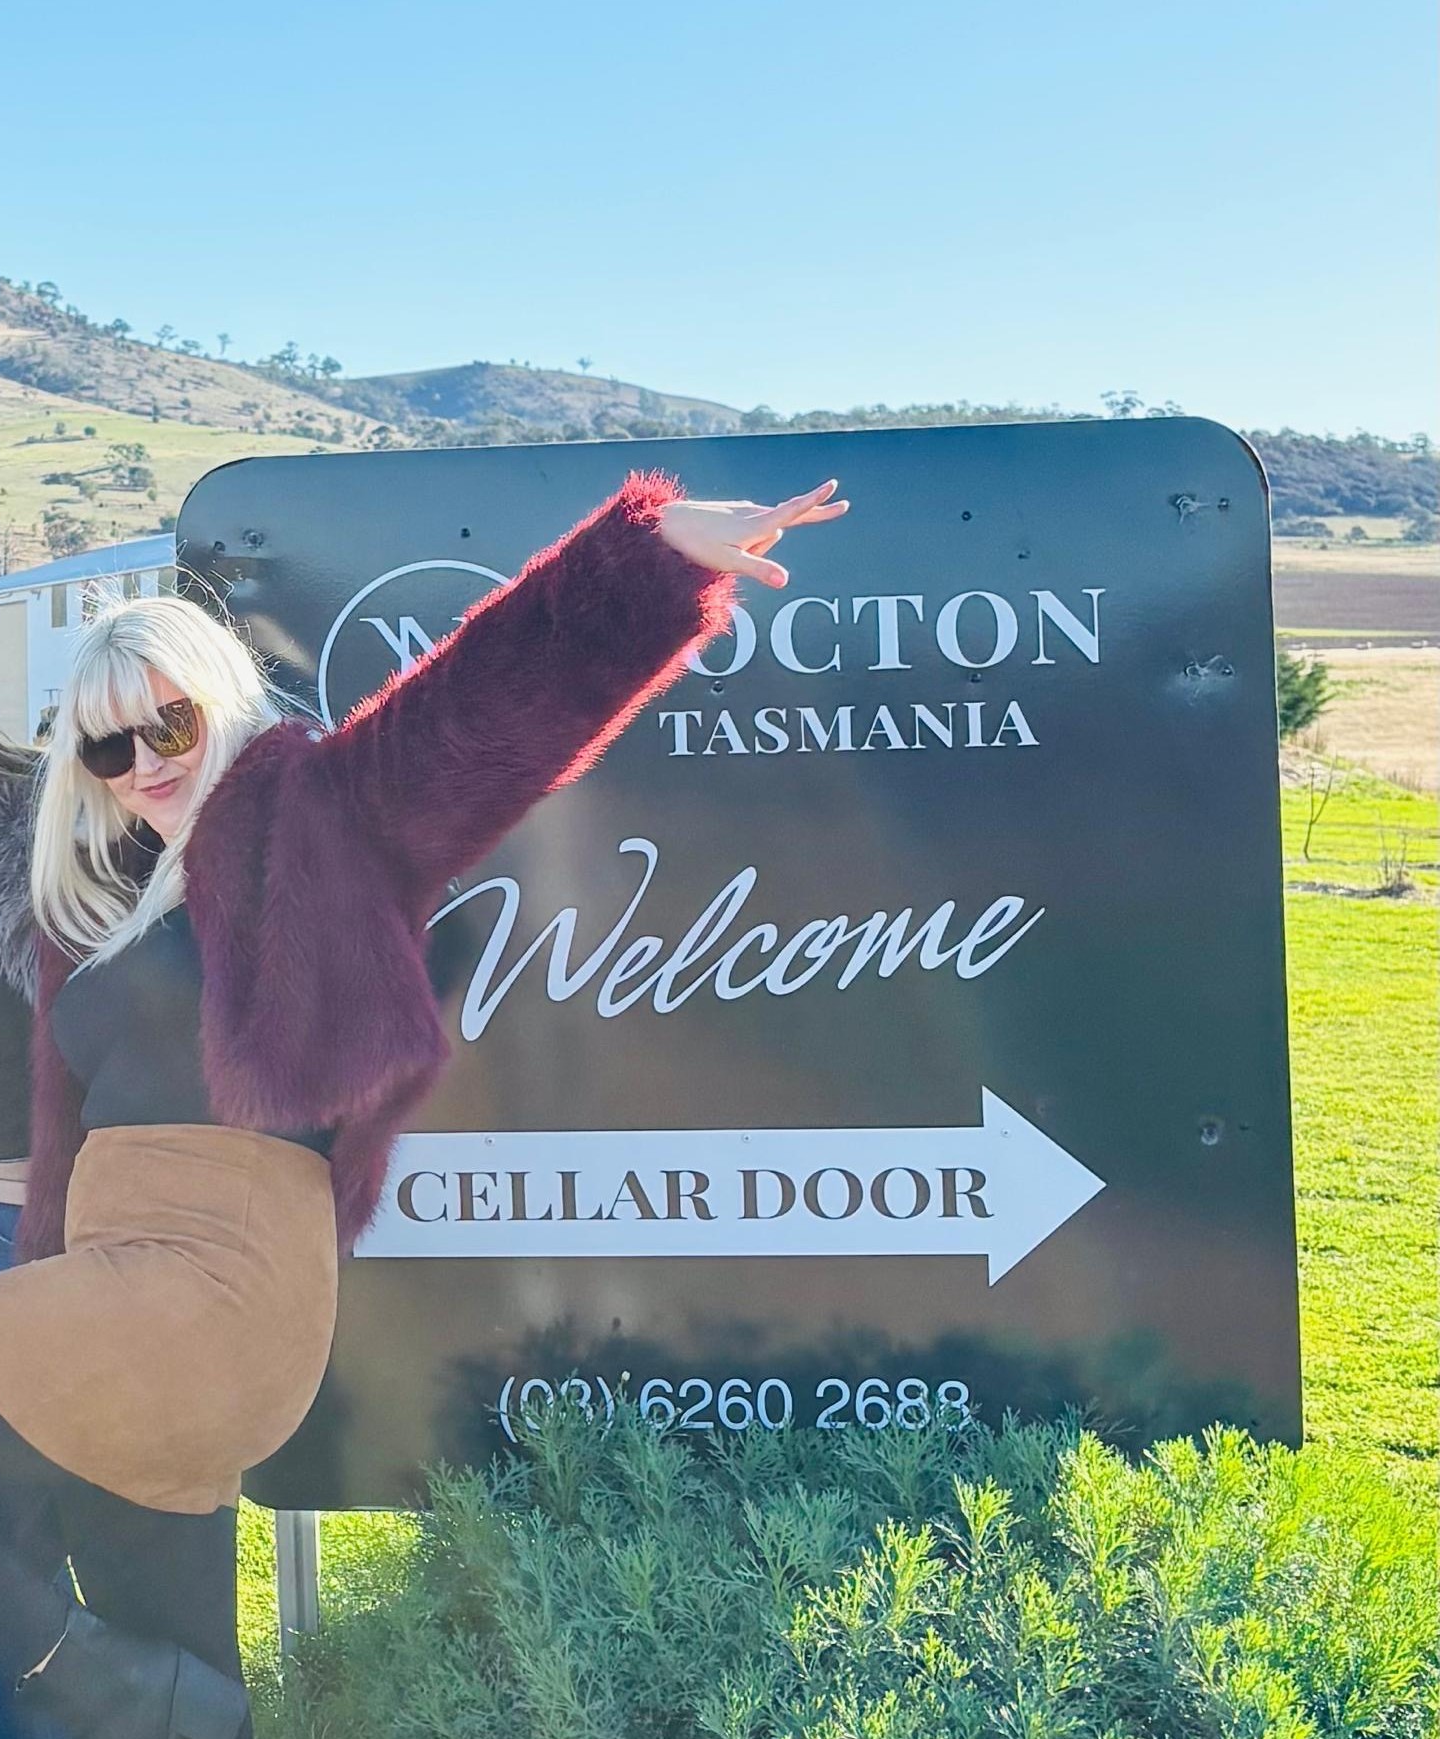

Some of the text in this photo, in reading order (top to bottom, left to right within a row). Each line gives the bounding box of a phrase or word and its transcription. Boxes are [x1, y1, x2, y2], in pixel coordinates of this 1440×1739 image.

[686, 588, 1107, 678] OCTON
[658, 700, 1040, 756] TASMANIA
[425, 837, 1045, 1042] Welcome
[396, 1167, 994, 1222] CELLAR DOOR
[640, 1378, 793, 1430] 6260
[815, 1378, 970, 1432] 2688
